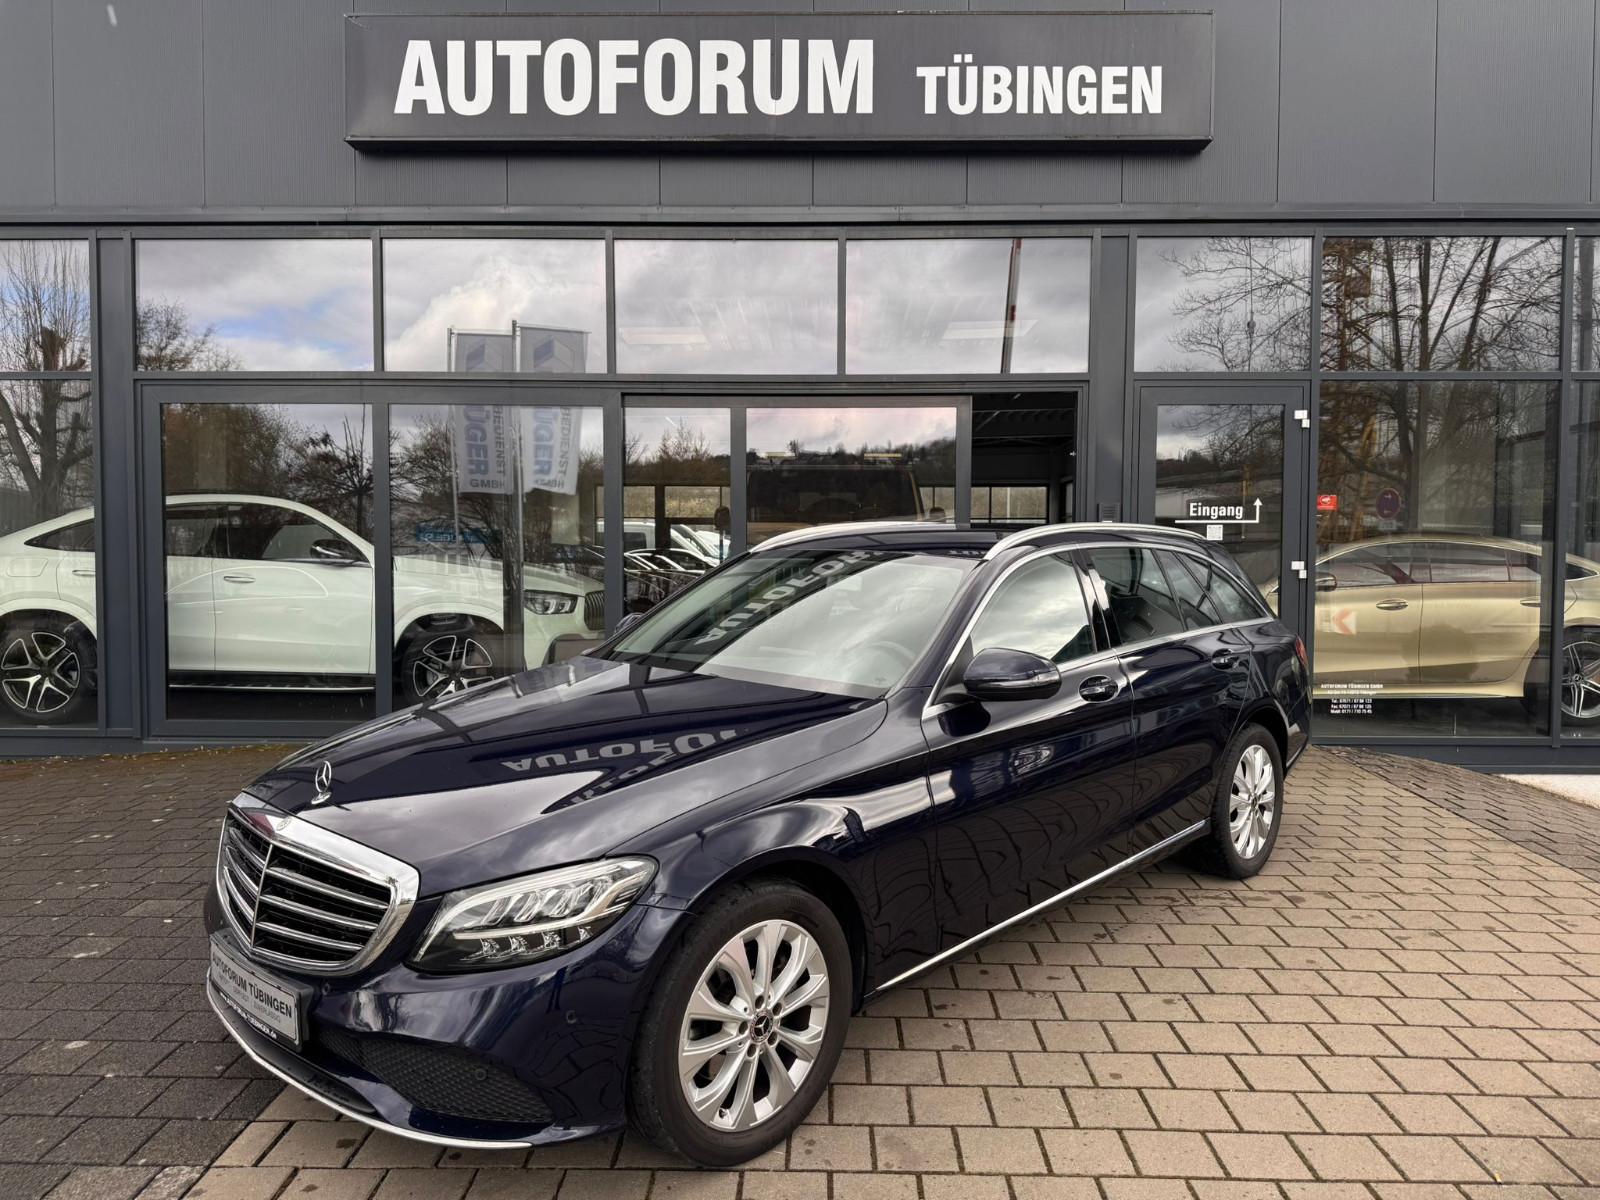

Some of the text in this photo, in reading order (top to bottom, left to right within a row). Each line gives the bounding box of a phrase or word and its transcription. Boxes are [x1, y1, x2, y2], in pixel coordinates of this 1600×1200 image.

[394, 38, 1163, 116] AUTOFORUM TÜBINGEN
[1189, 502, 1244, 520] Eingang
[248, 981, 292, 1019] TÜBINGEN
